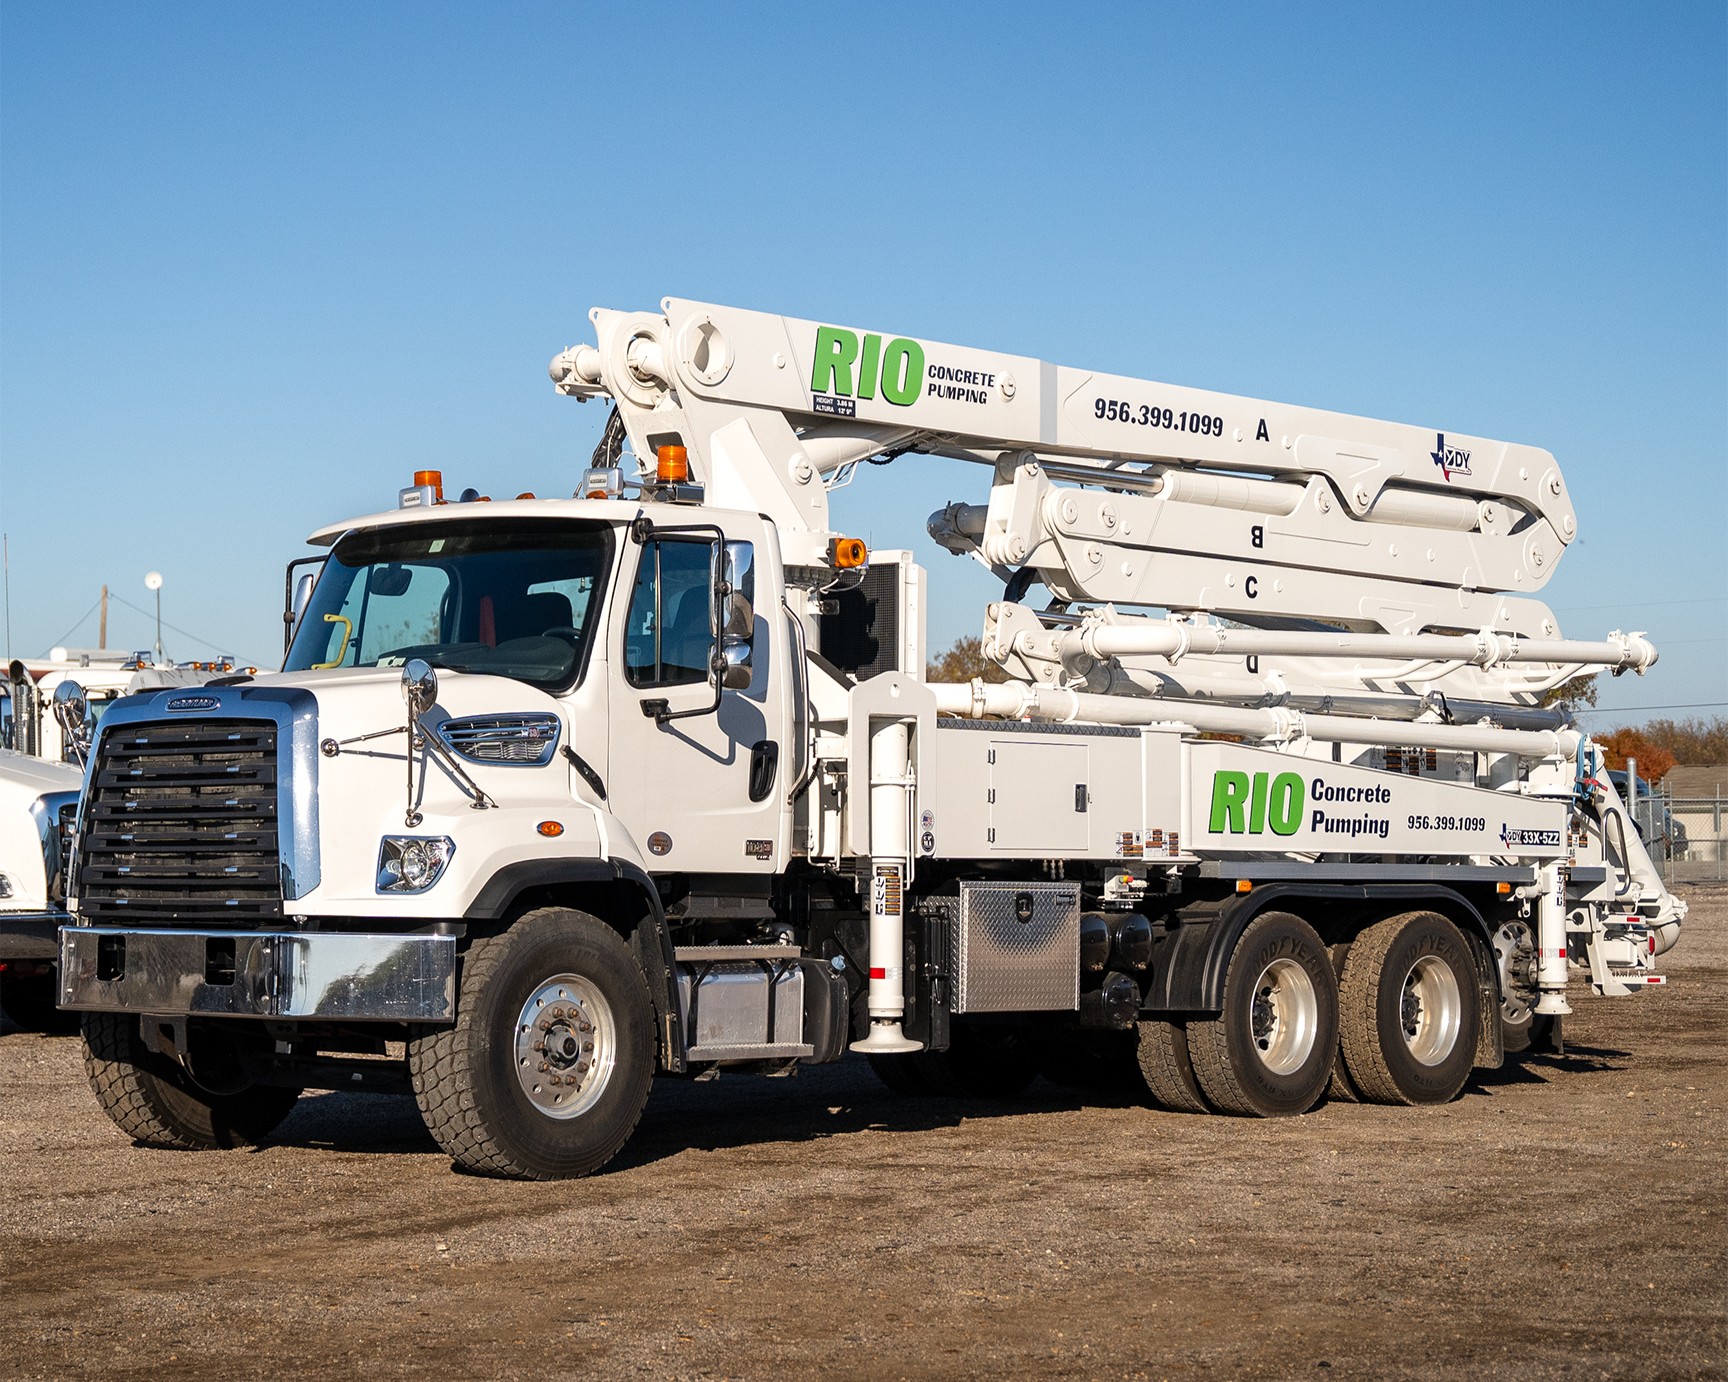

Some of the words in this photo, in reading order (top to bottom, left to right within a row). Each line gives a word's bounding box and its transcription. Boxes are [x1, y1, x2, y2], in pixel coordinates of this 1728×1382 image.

[810, 325, 925, 407] RIO
[927, 364, 996, 388] CONCRETE
[927, 383, 988, 405] PUMPING
[1094, 397, 1224, 437] 956.399.1099
[1255, 418, 1270, 442] A
[1250, 525, 1264, 549] B
[1245, 575, 1258, 599] C
[1208, 770, 1306, 836] RIO
[1311, 778, 1391, 804] Concrete
[1311, 810, 1390, 839] Pumping
[1407, 815, 1486, 832] 956.399.1099
